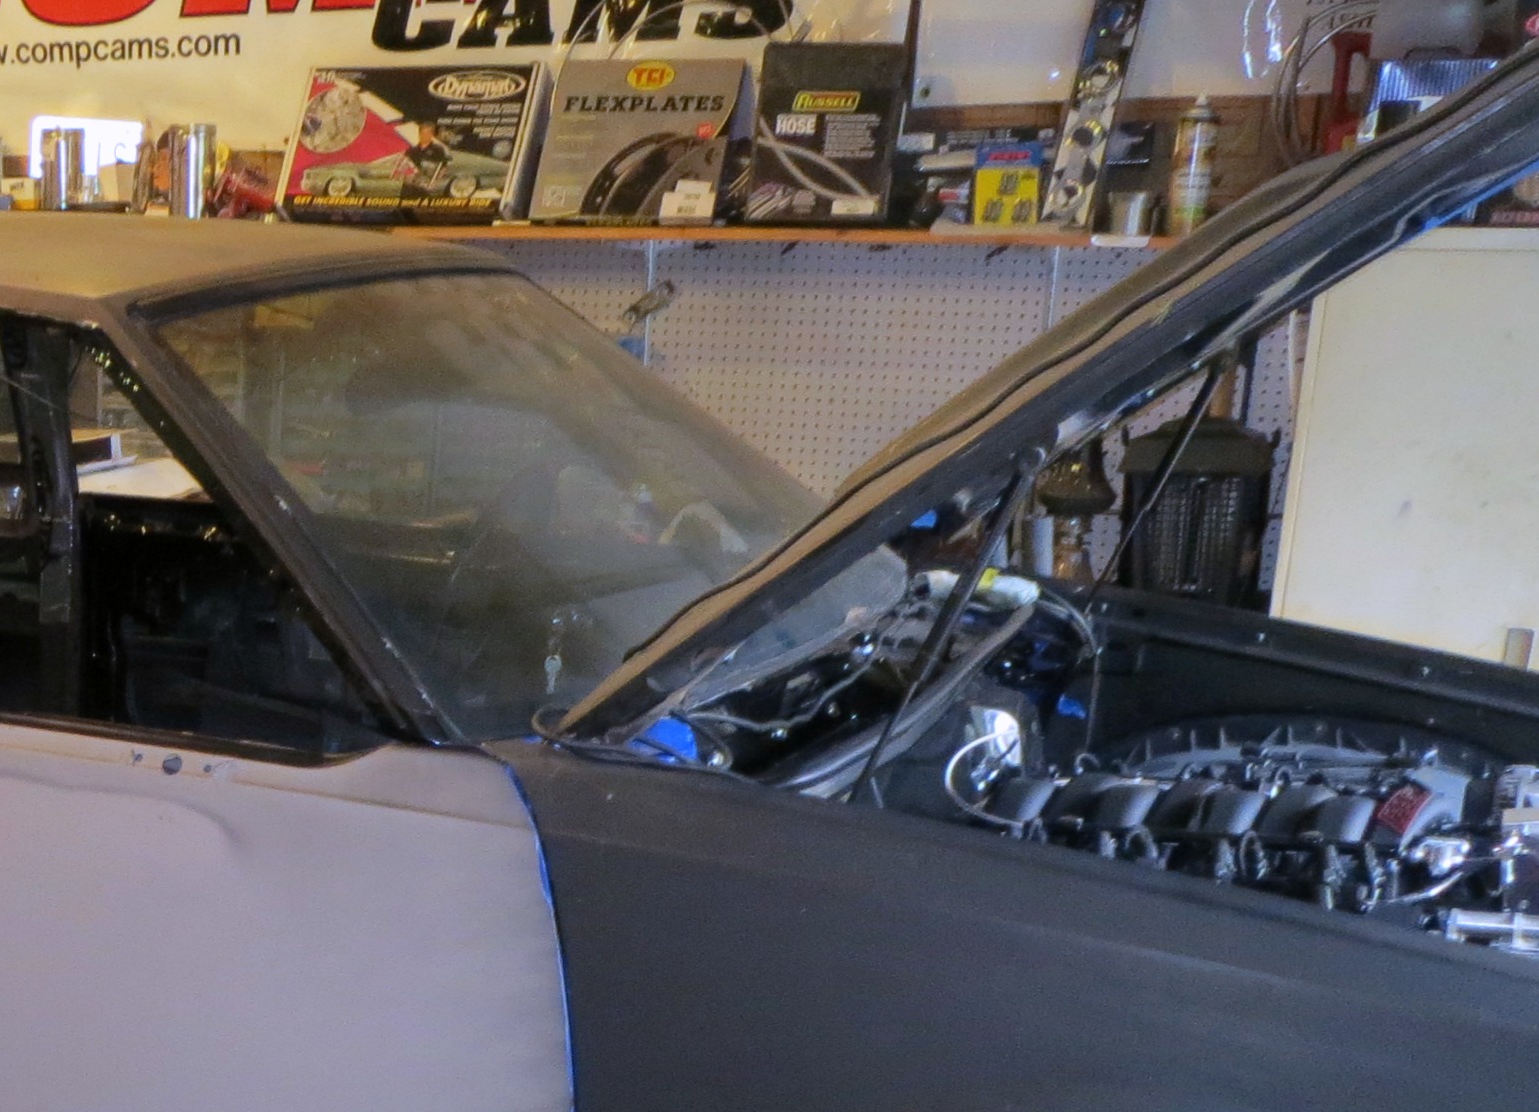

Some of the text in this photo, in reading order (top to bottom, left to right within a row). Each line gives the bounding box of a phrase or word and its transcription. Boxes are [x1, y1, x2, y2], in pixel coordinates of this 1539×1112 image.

[633, 68, 667, 85] TCI
[563, 94, 726, 113] FLEXPLATES
[775, 116, 817, 136] HOSE
